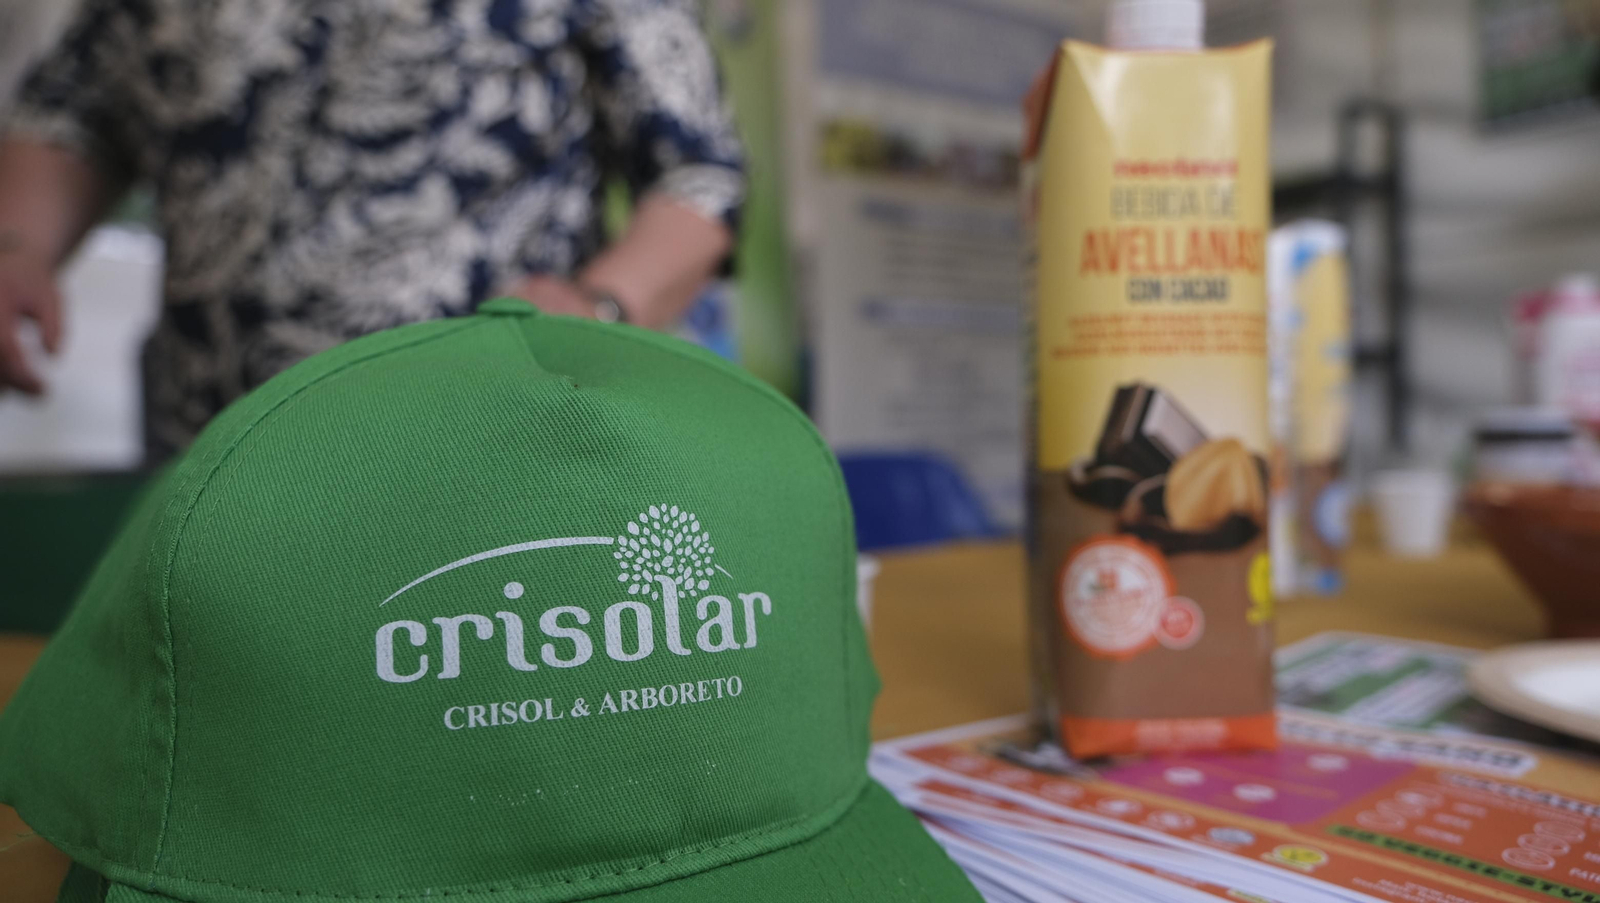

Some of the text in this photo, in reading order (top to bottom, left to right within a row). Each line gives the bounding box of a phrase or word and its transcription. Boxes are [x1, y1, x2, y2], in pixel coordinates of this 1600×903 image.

[1127, 279, 1162, 302] CON
[375, 575, 772, 683] crisolar
[443, 675, 743, 731] CRISOL & ARBORETO
